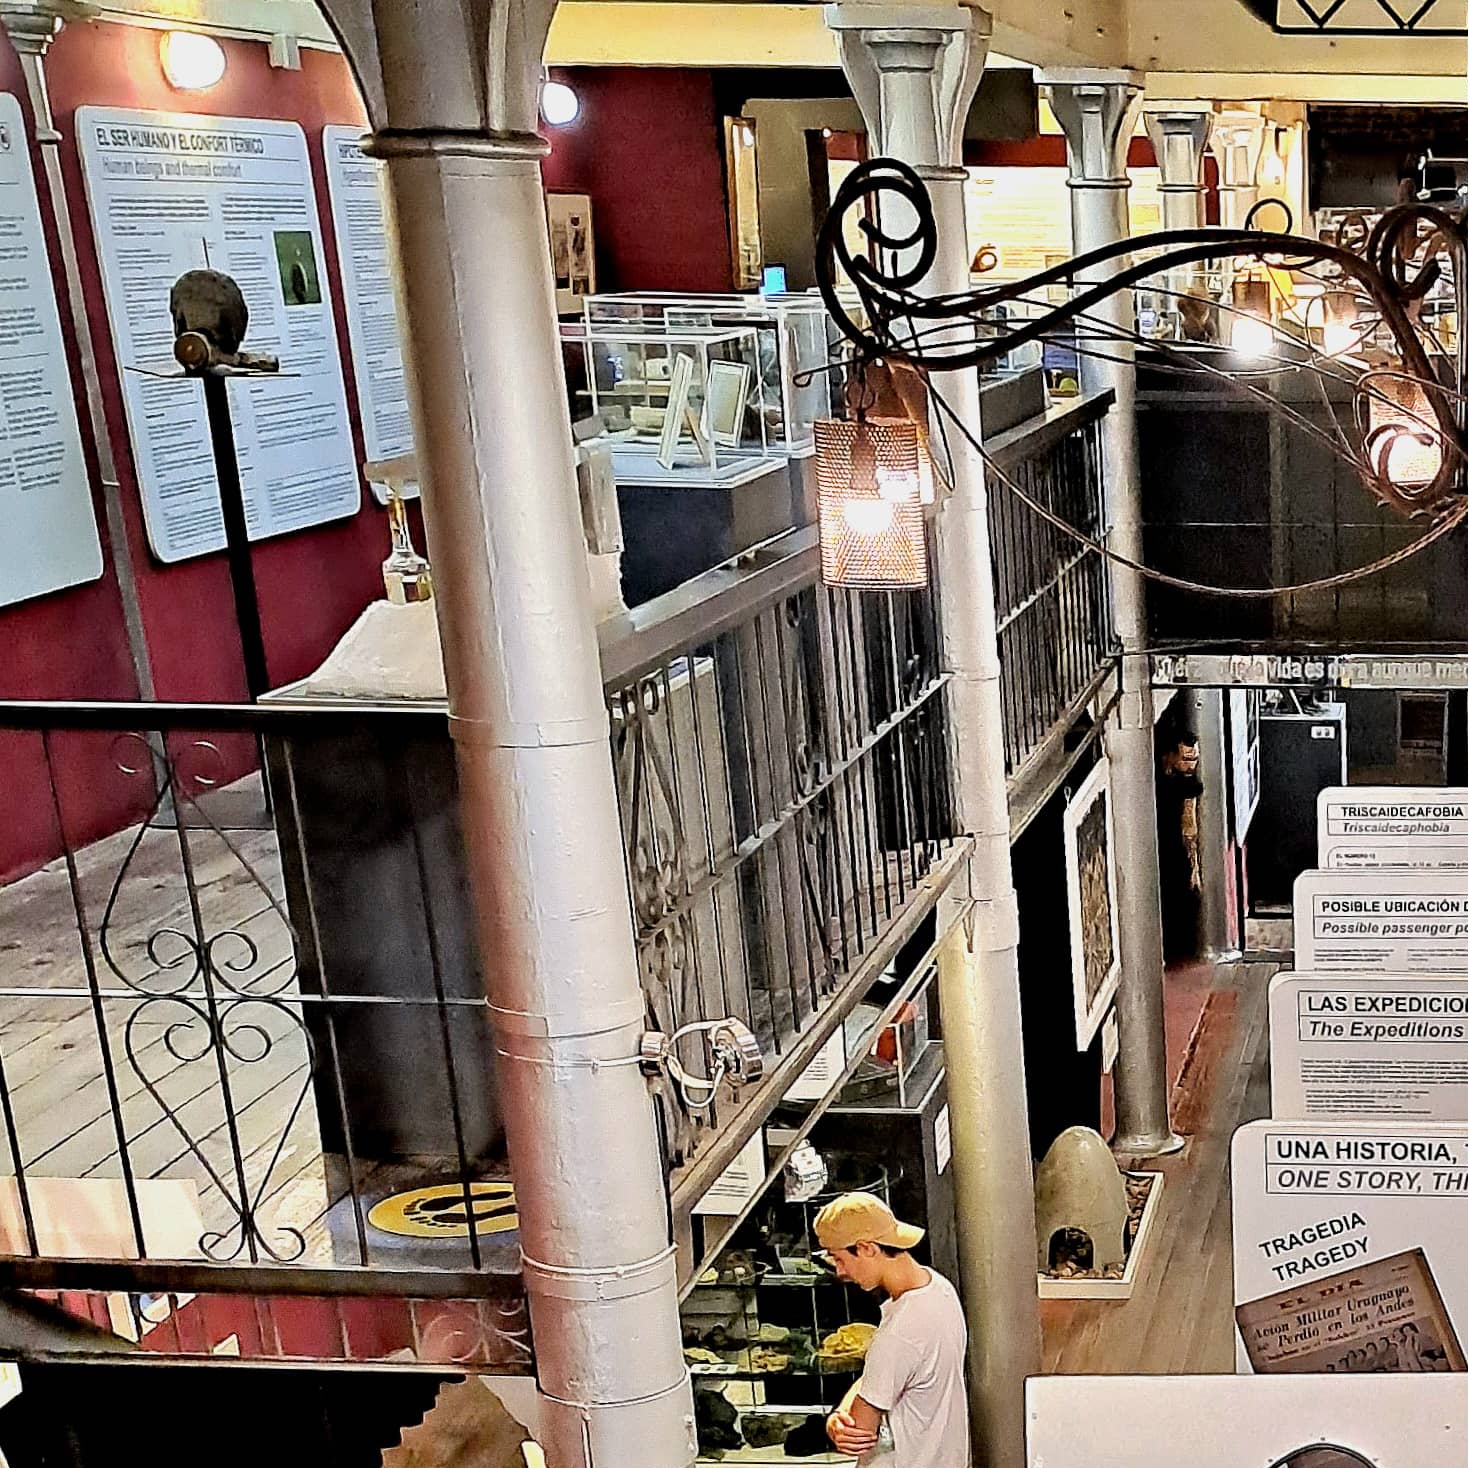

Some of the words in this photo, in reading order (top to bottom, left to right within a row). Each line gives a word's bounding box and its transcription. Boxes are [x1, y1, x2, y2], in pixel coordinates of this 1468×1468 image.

[96, 127, 110, 147] EL
[111, 128, 130, 148] SER
[1341, 805, 1464, 819] TRISCAIDECAFOBIA
[1342, 821, 1450, 836] Triscaidecaphobia
[1321, 901, 1382, 914] POSIBLE
[1384, 897, 1459, 914] UBICACIÓN
[1321, 920, 1379, 935] Possible
[1382, 922, 1452, 938] passenger
[1308, 995, 1349, 1013] LAS
[1309, 1020, 1345, 1038] The
[1350, 1020, 1465, 1040] Expeditions
[1277, 1140, 1328, 1160] UNA
[1335, 1141, 1458, 1165] HISTORIA,
[1277, 1169, 1330, 1188] ONE
[1336, 1170, 1424, 1194] STORY,
[1259, 1212, 1366, 1258] TRAGEDIA
[1272, 1236, 1369, 1281] TRAGEDY
